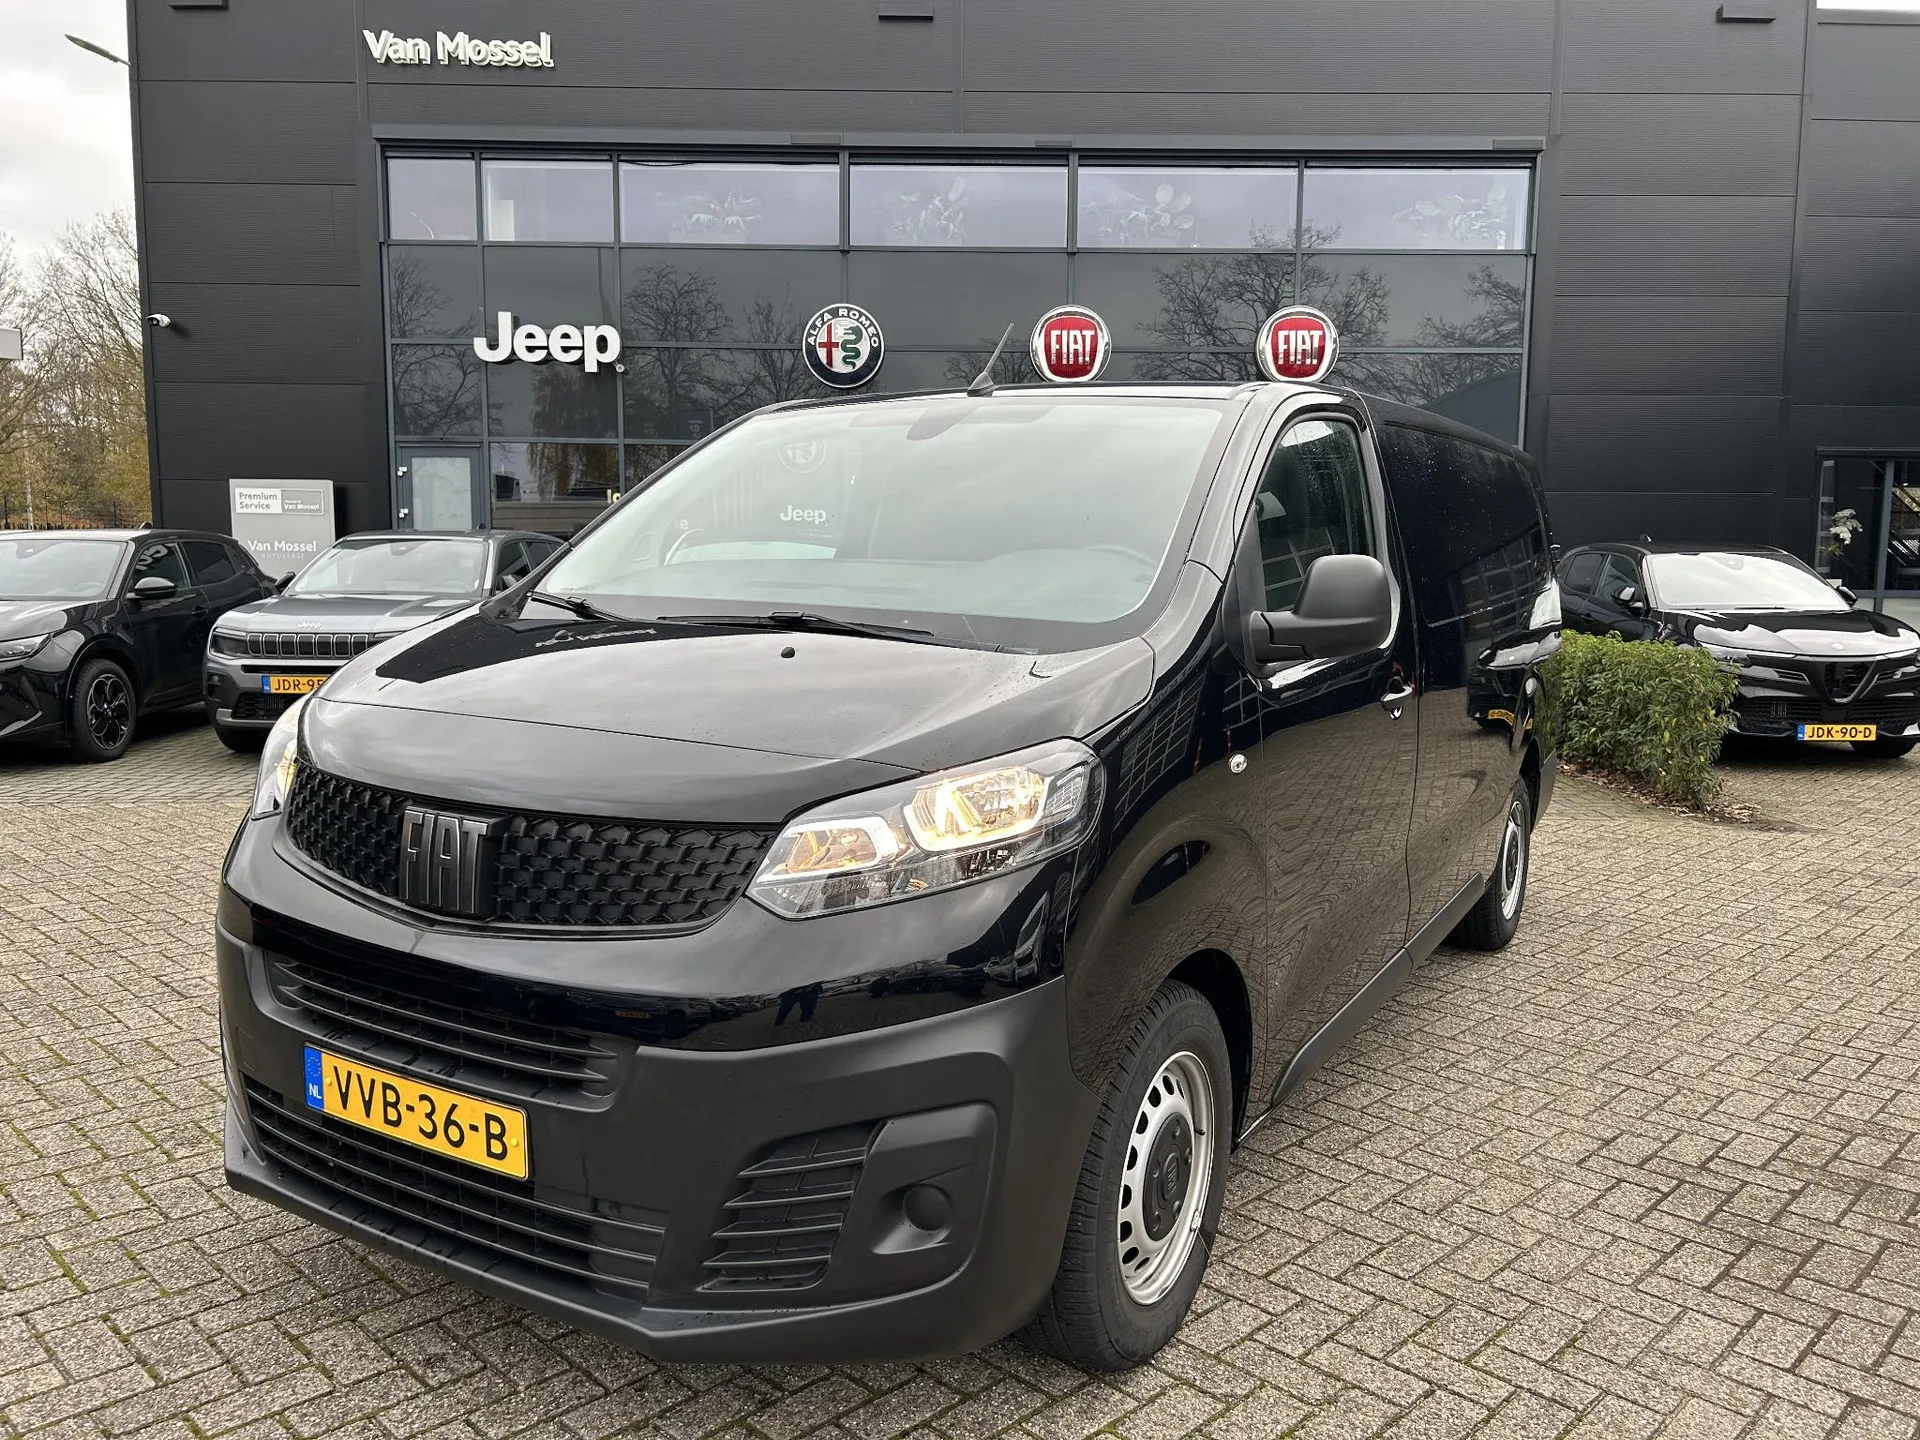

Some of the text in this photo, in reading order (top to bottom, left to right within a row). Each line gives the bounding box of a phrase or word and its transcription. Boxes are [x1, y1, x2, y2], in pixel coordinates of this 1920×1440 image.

[362, 29, 555, 68] Van Mossel
[473, 311, 622, 373] Jeep
[807, 308, 879, 347] ALFA ROMEO
[1050, 329, 1095, 365] FIAT
[1277, 329, 1323, 365] FIAT
[239, 492, 278, 500] Premium
[239, 501, 271, 510] Service
[779, 504, 827, 525] Jeep
[247, 540, 317, 552] Van Mossel
[1808, 726, 1872, 739] JDK-90-D
[399, 809, 489, 914] FIAT
[309, 1083, 322, 1100] NL
[333, 1065, 508, 1161] VVB-36-B
